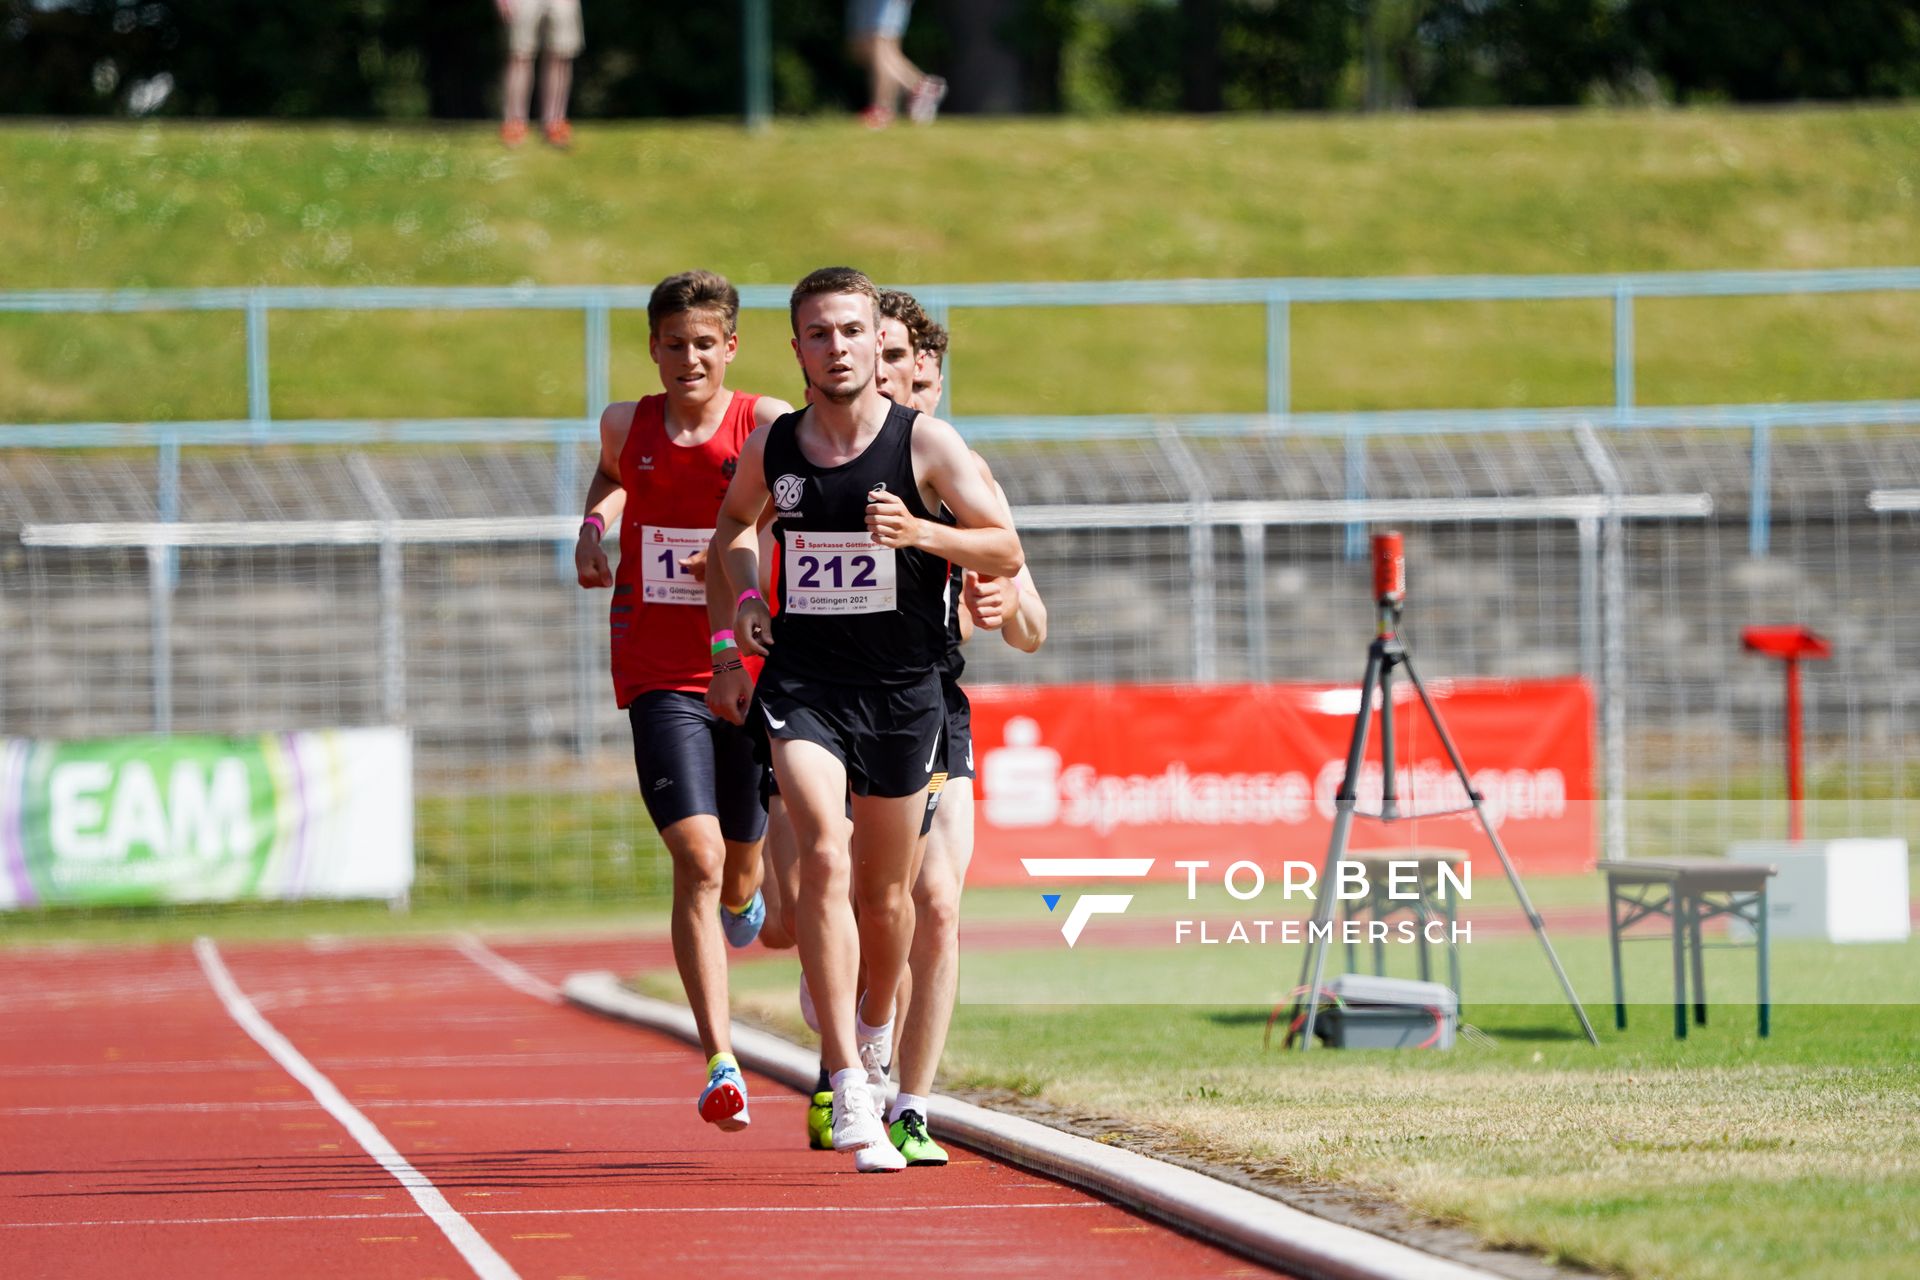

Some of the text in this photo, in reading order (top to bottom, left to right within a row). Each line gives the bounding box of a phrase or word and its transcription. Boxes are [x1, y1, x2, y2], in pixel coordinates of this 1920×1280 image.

[773, 474, 806, 510] 96
[798, 555, 877, 588] 212
[810, 595, 868, 605] Göttingen 2021
[50, 758, 252, 859] EAM
[1060, 761, 1311, 836] Sparkasse
